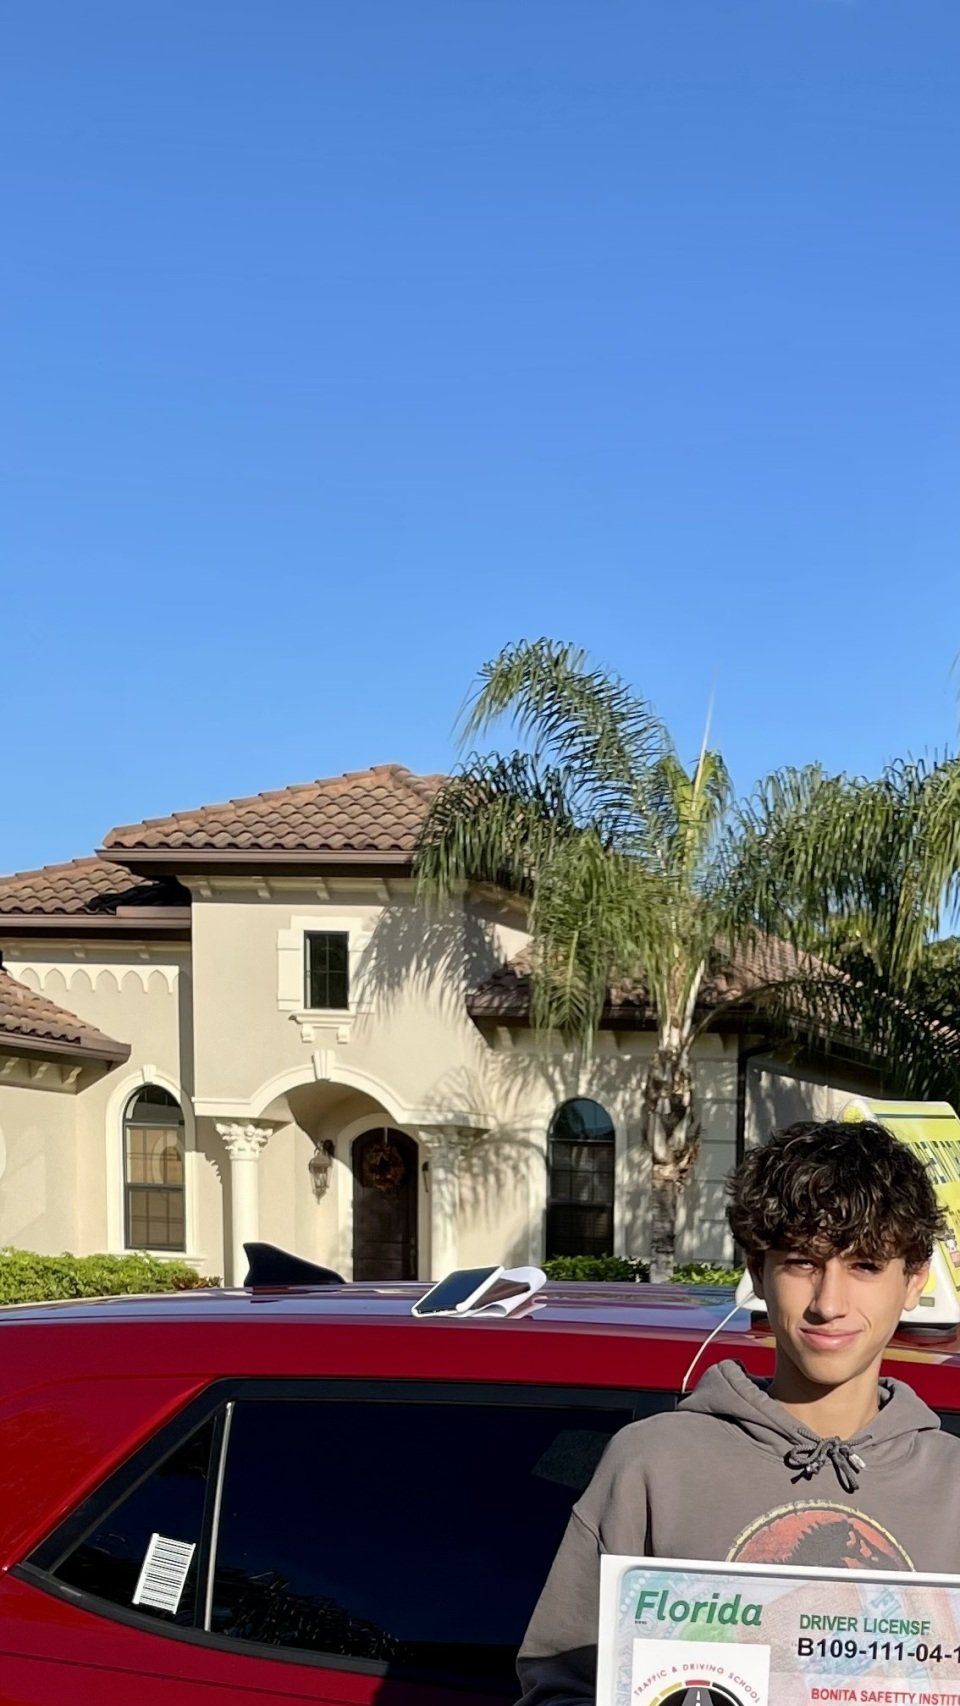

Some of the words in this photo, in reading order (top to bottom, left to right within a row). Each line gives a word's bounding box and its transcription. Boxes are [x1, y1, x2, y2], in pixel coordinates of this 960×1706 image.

[635, 1590, 763, 1626] Florida
[799, 1614, 858, 1632] DRIVER
[634, 1669, 667, 1696] TRAFFIC
[683, 1663, 725, 1675] DRIVING
[728, 1672, 761, 1704] SCHOOL
[811, 1688, 857, 1702] BONITA
[860, 1691, 916, 1705] SAFETTY
